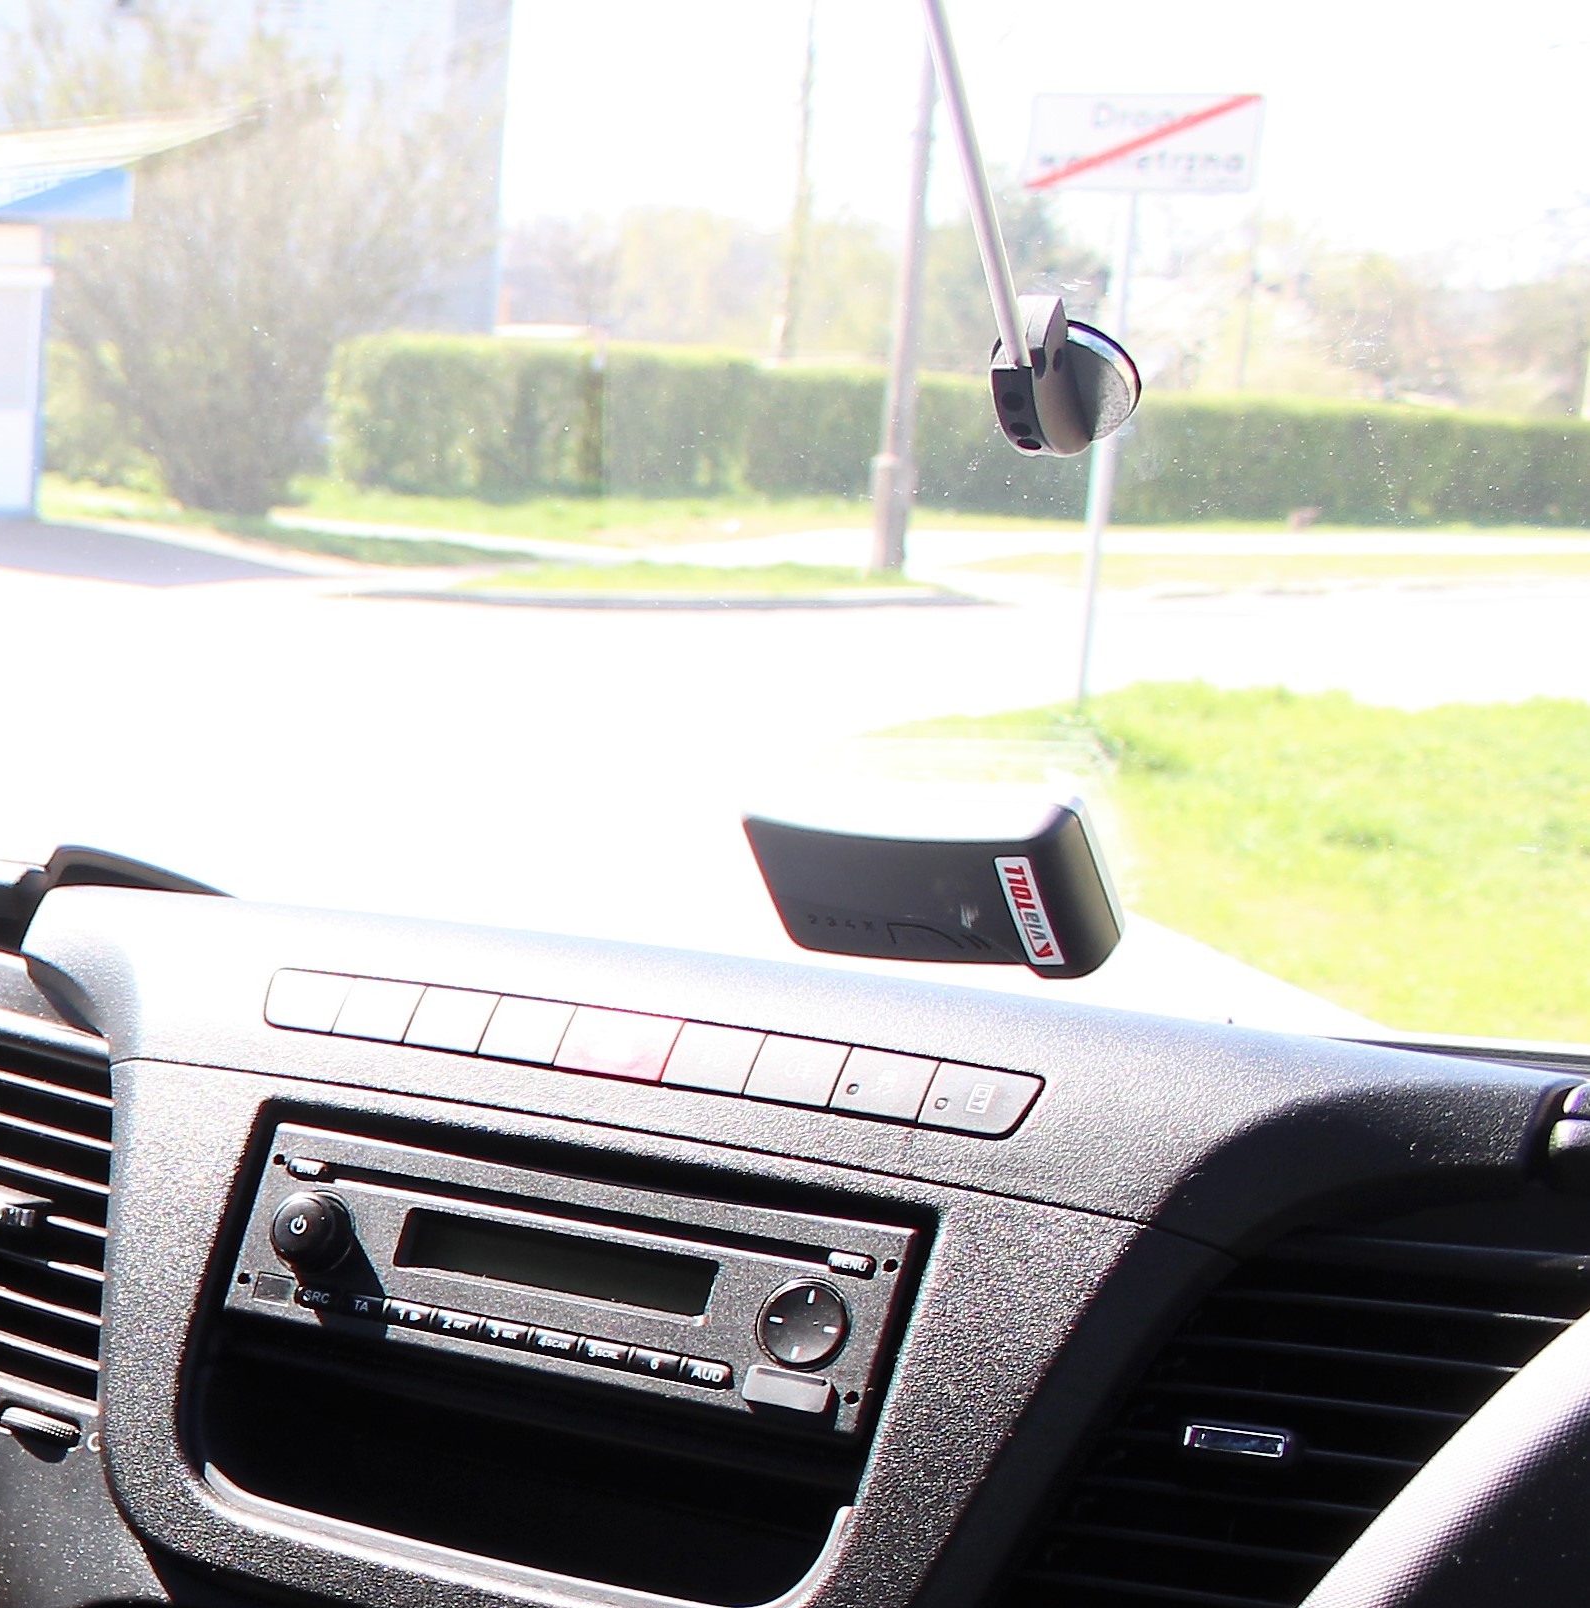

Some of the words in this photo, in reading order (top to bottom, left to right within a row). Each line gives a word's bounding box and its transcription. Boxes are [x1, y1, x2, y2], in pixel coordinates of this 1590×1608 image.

[1091, 100, 1201, 131] Dro
[1004, 864, 1047, 944] viaTOLL
[831, 1258, 869, 1272] MENU
[303, 1288, 330, 1304] SRC
[353, 1299, 370, 1312] TA
[649, 1357, 660, 1371] 6
[691, 1366, 724, 1383] AUD
